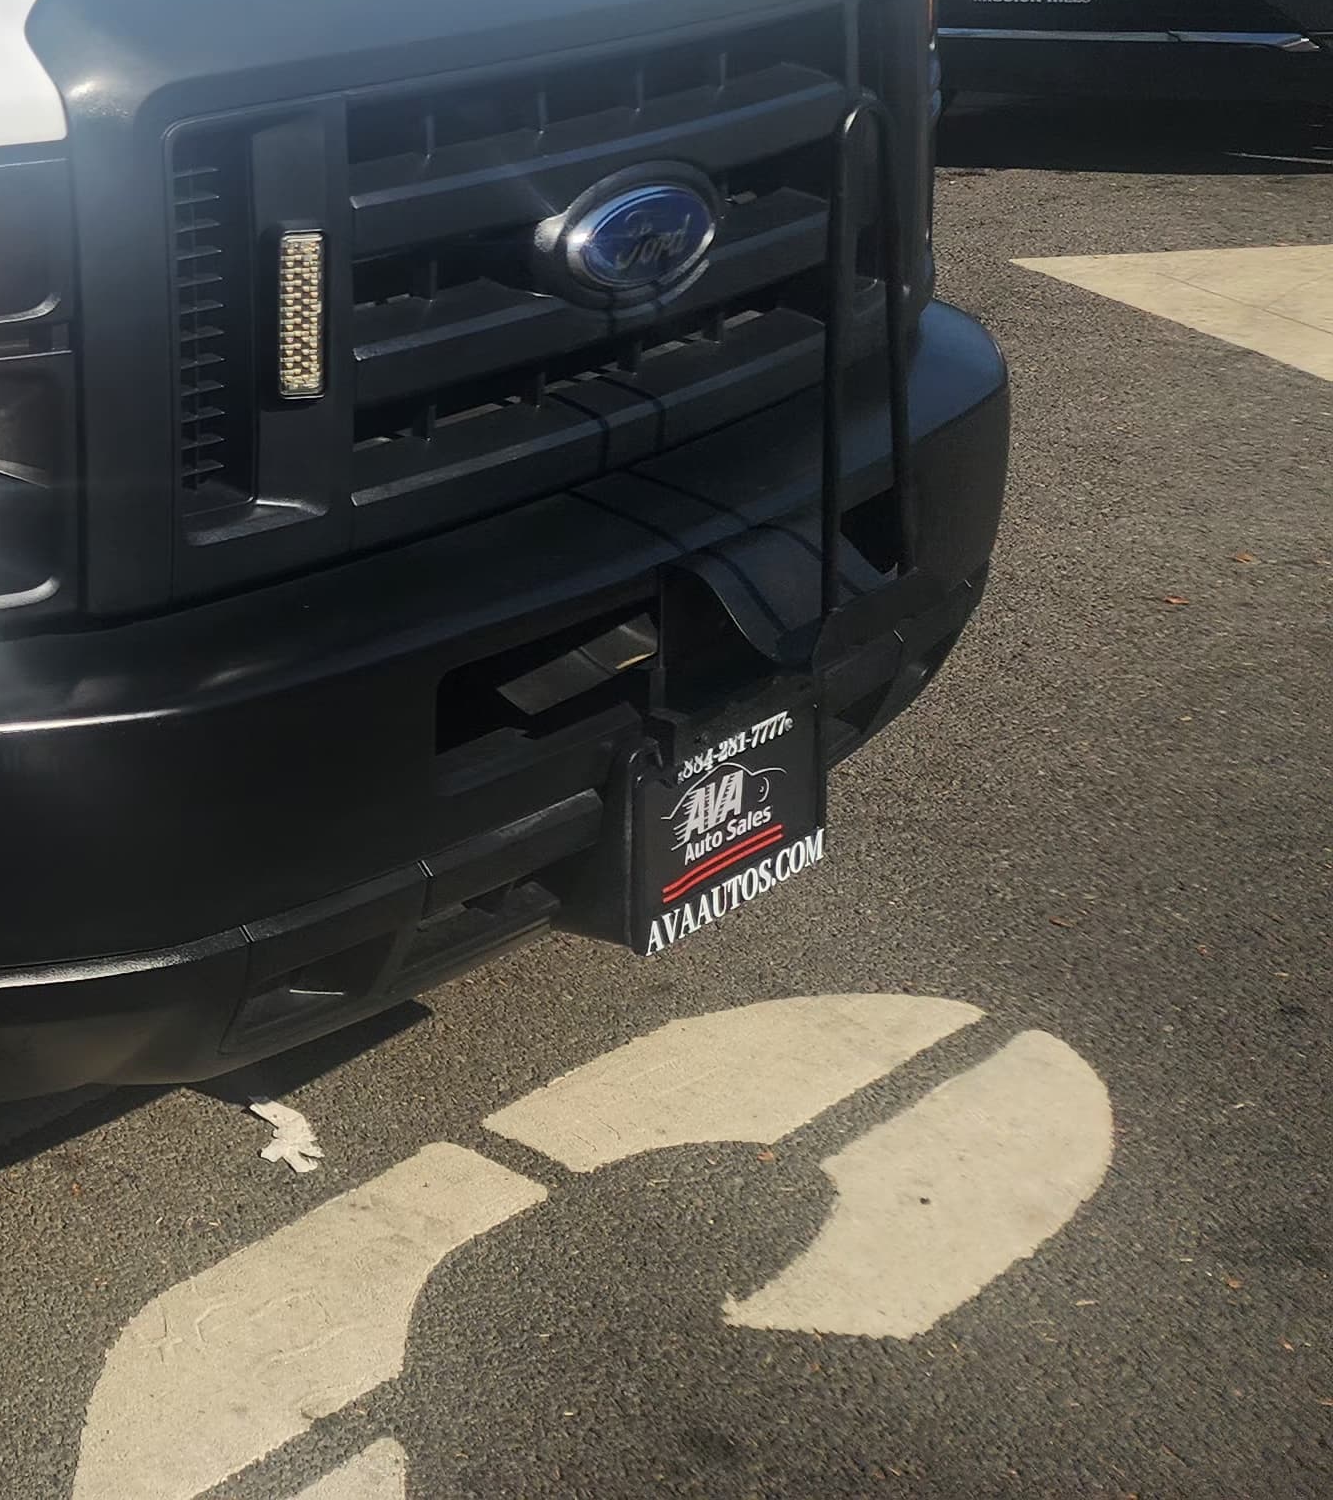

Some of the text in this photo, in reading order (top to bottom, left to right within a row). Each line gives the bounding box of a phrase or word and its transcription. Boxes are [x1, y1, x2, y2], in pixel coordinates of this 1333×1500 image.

[679, 769, 744, 845] AVA
[684, 805, 773, 867] Auto Sales
[645, 827, 825, 957] AVAAUTOS.COM
